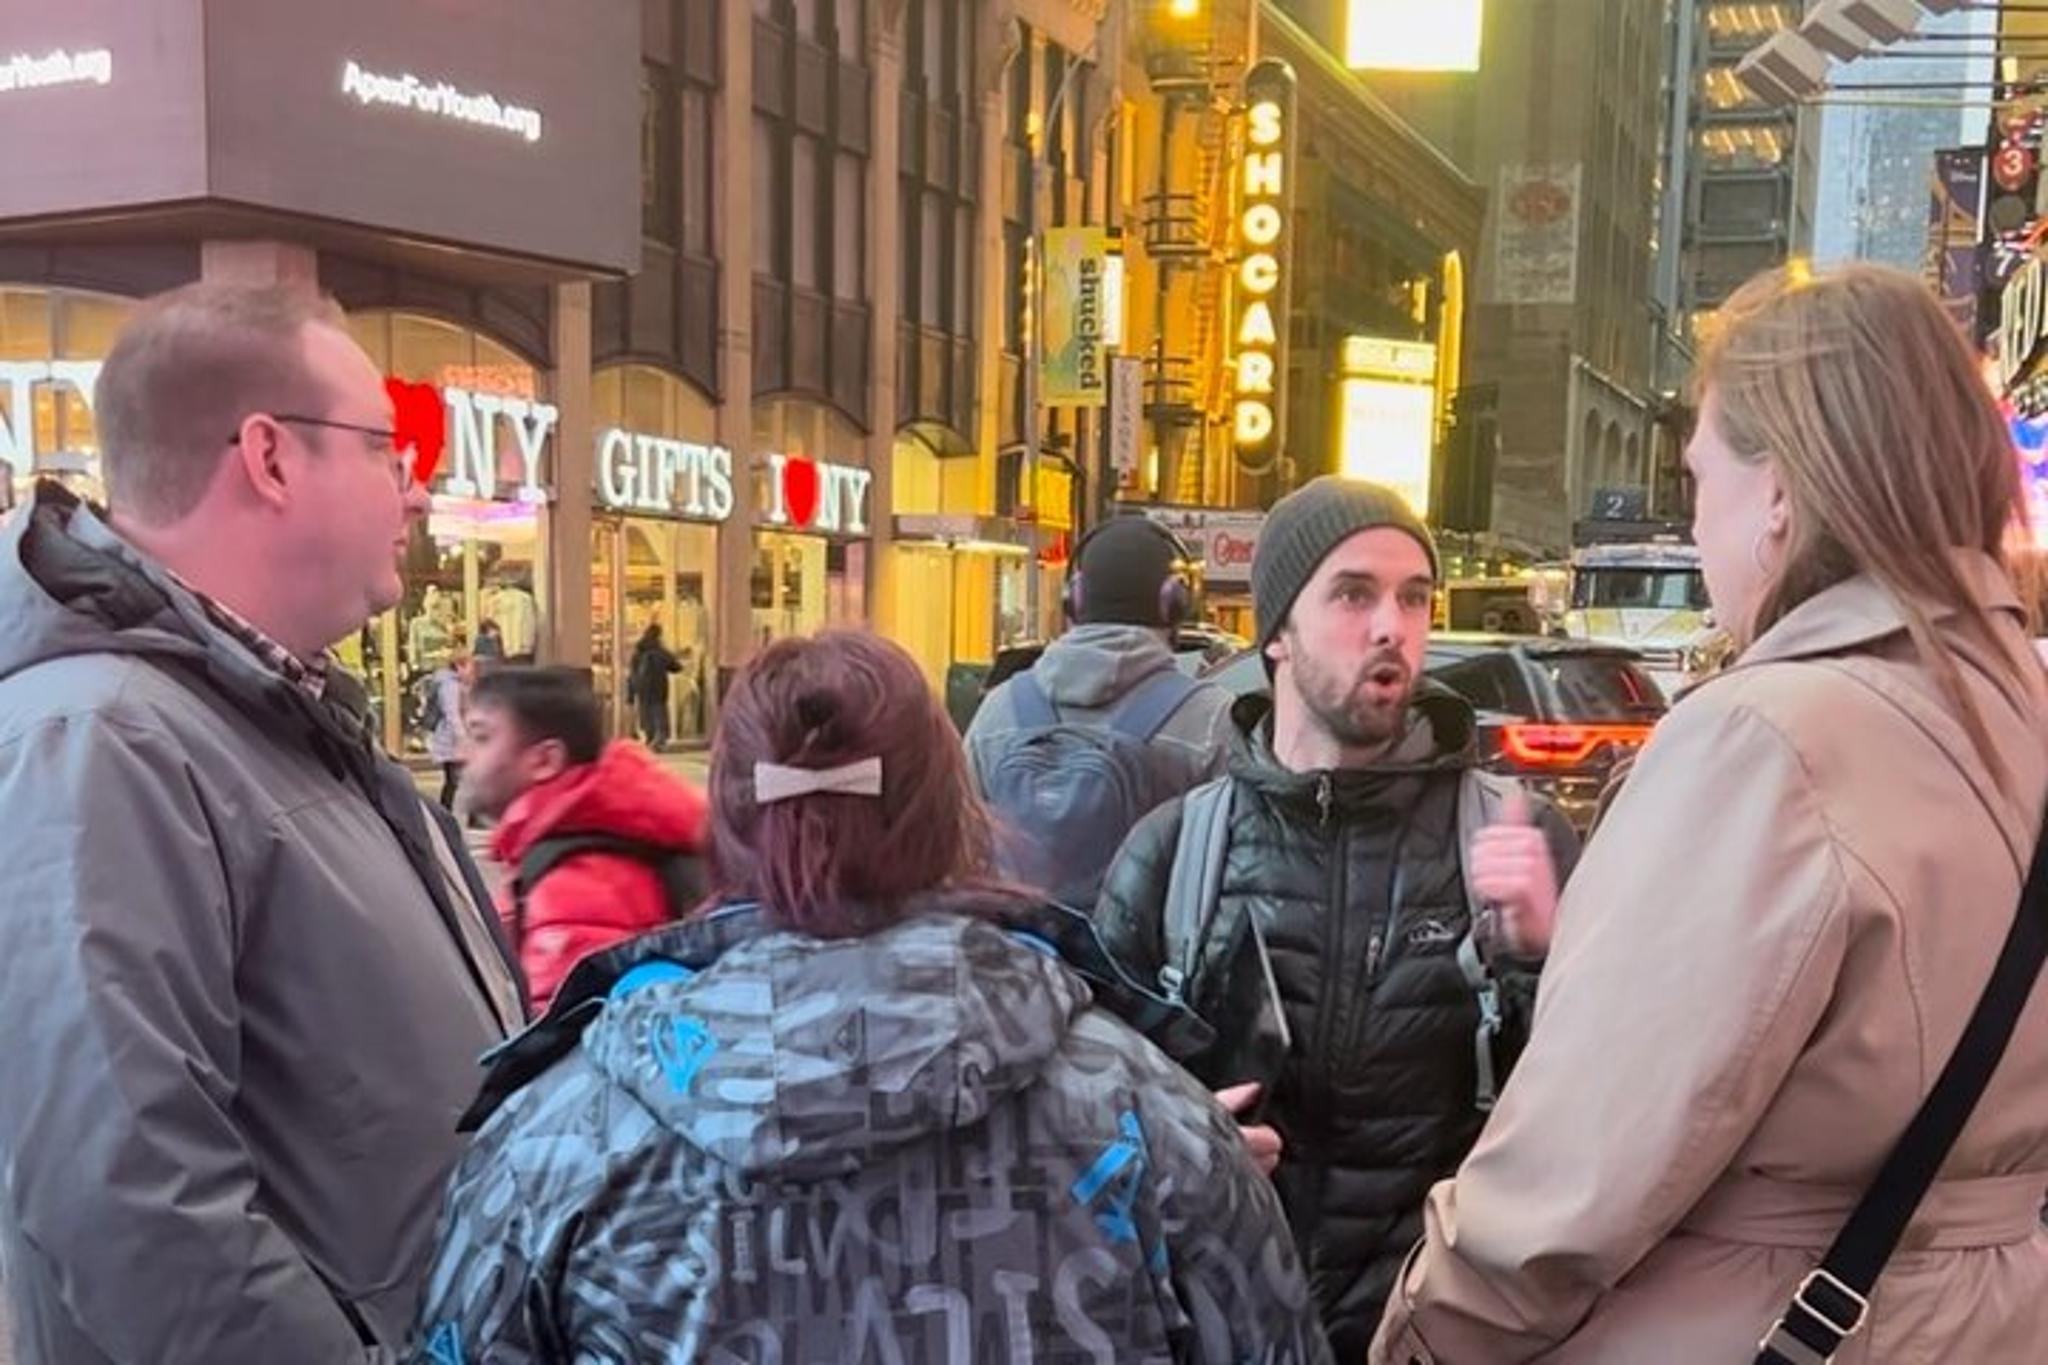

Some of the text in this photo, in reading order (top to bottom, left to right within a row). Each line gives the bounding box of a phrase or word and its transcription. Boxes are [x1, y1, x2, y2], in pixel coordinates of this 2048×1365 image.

[342, 59, 541, 142] ApexForYouth.org
[2002, 150, 2024, 176] 3
[1234, 100, 1282, 444] SHOCARD
[1080, 257, 1101, 390] shucked
[444, 386, 559, 504] NY
[600, 428, 733, 522] GIFTS
[815, 462, 872, 534] NY
[1606, 496, 1624, 519] 2
